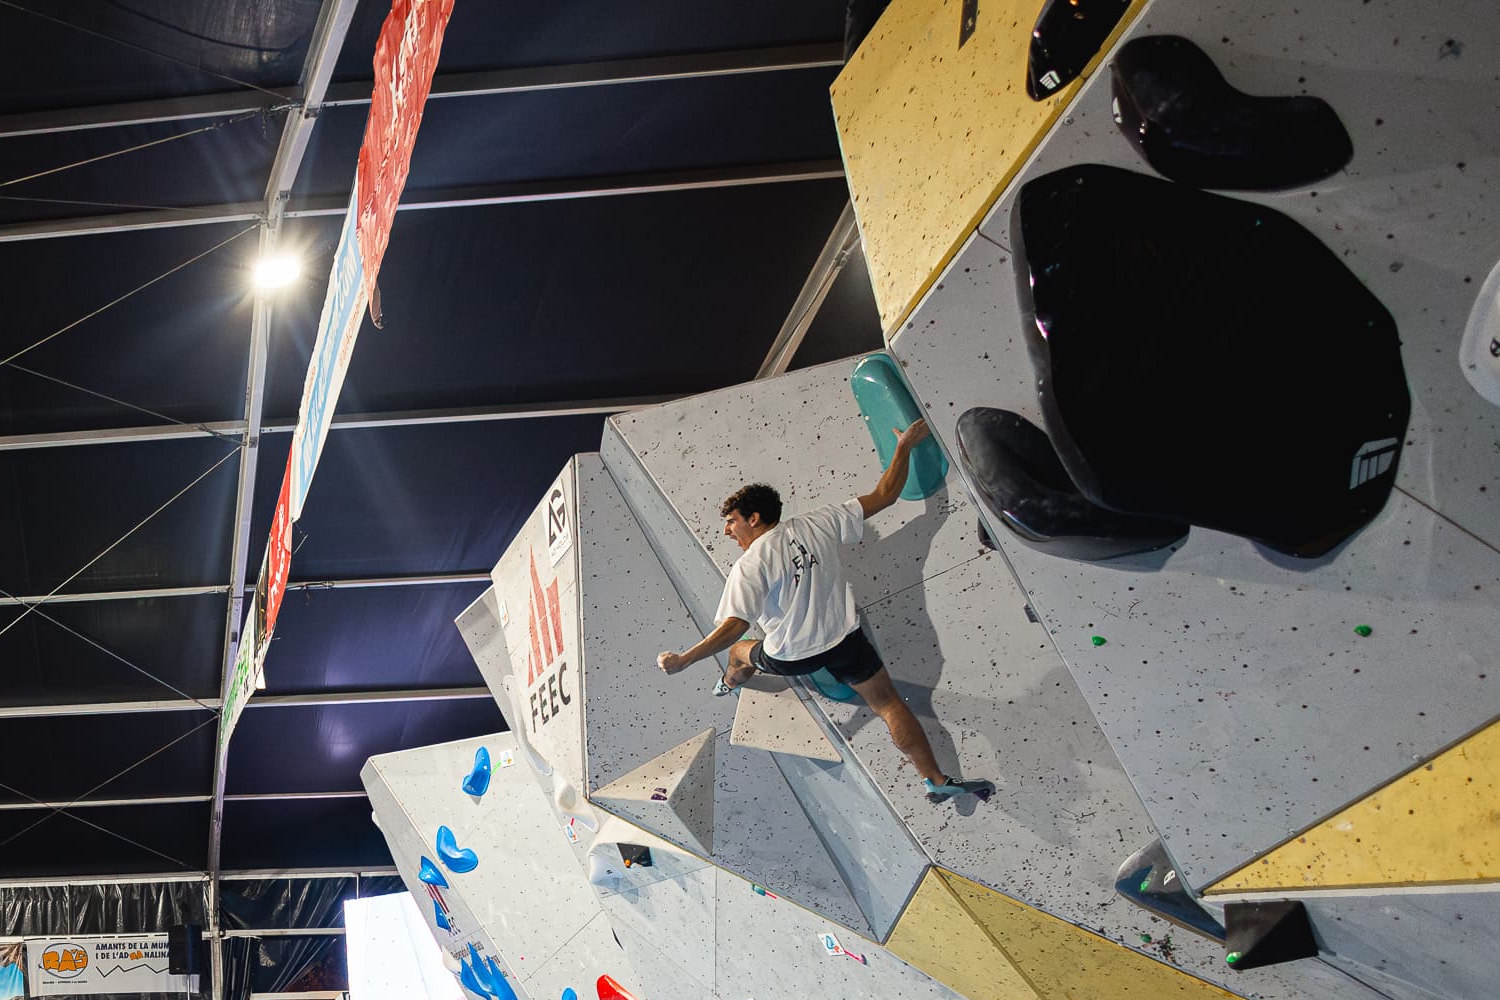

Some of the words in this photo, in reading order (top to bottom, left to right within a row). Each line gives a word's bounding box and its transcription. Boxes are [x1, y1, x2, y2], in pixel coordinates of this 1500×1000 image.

[529, 662, 571, 733] FEEC
[95, 942, 126, 950] AMANTS
[128, 942, 138, 950] DE
[150, 941, 169, 950] MUN
[100, 952, 110, 960] DE
